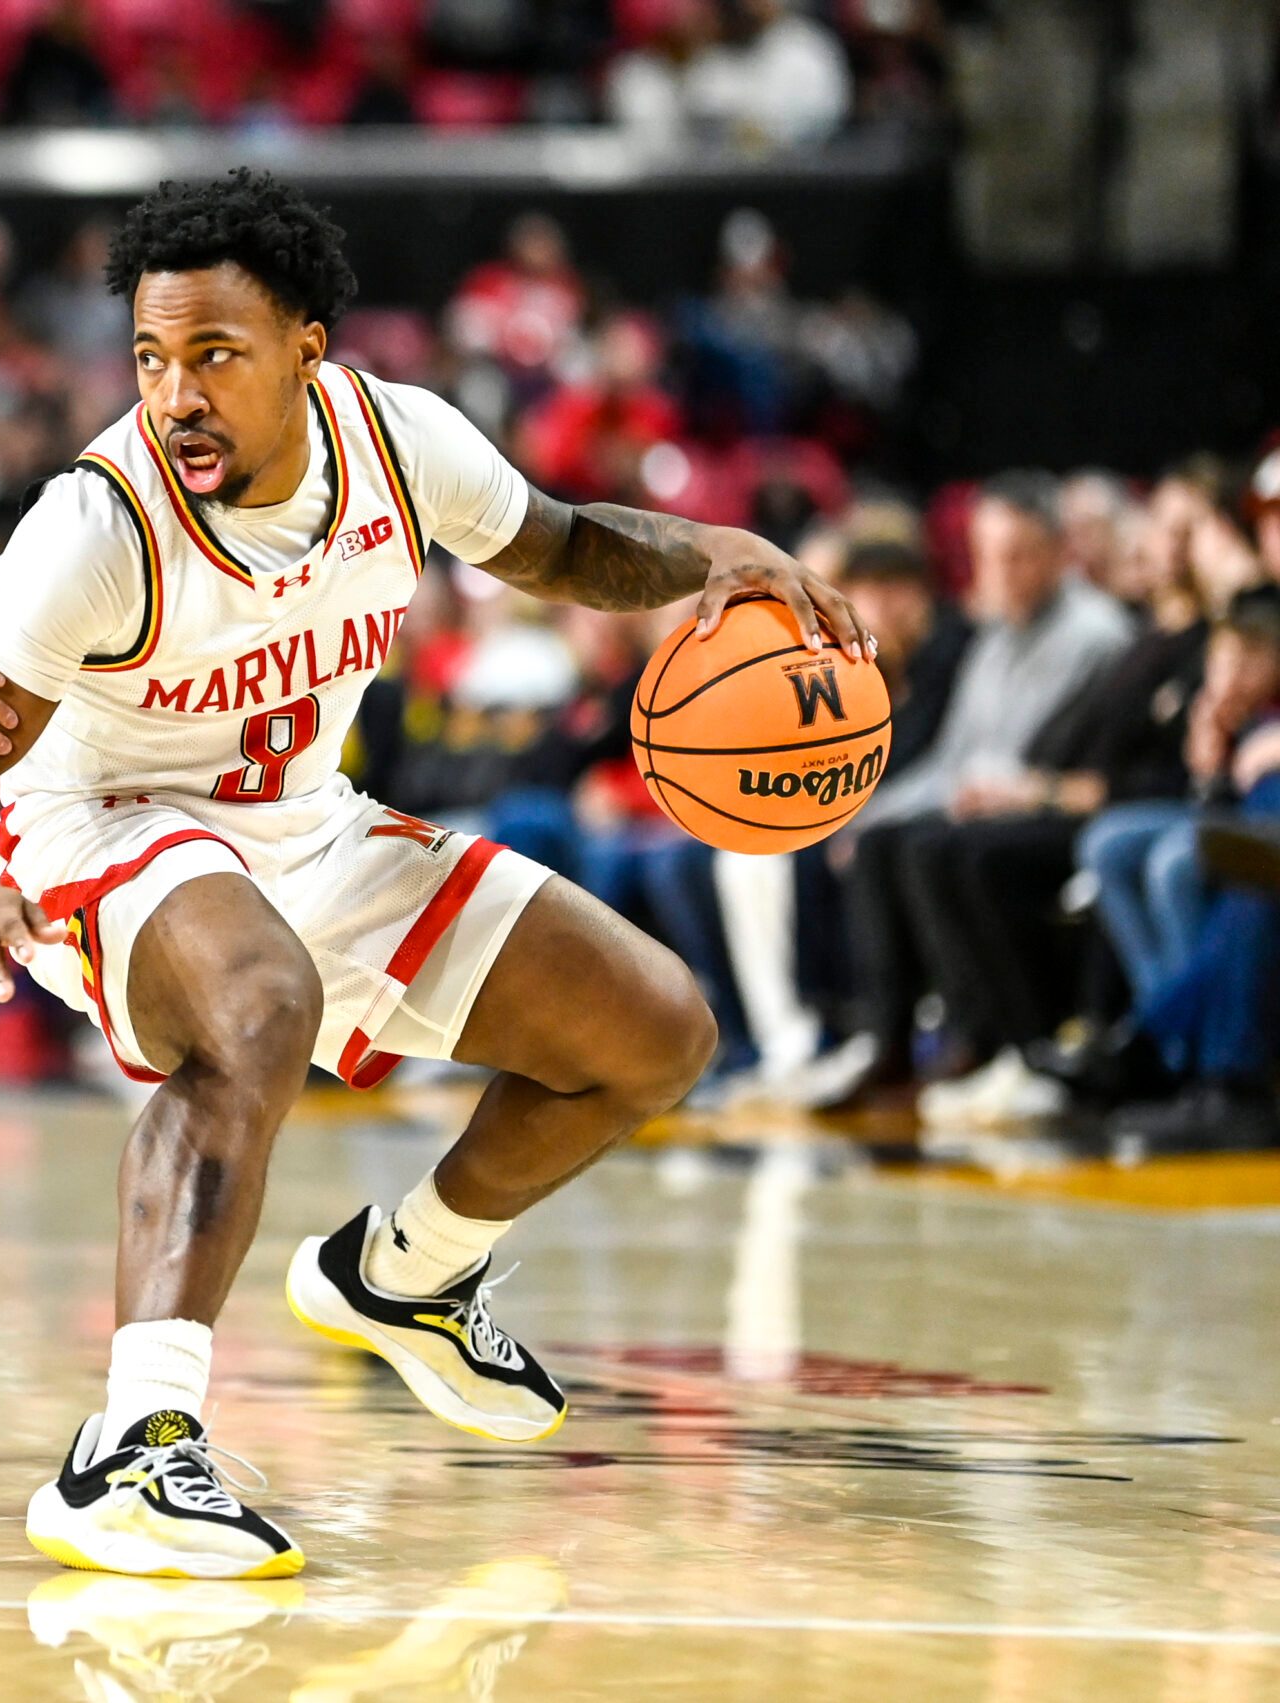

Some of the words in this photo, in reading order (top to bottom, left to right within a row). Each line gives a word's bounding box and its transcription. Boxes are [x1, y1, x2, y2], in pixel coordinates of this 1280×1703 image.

[785, 666, 848, 729] M
[210, 693, 320, 803] 8
[738, 745, 883, 806] Wilson
[801, 760, 825, 769] NXT
[828, 753, 848, 765] EVO
